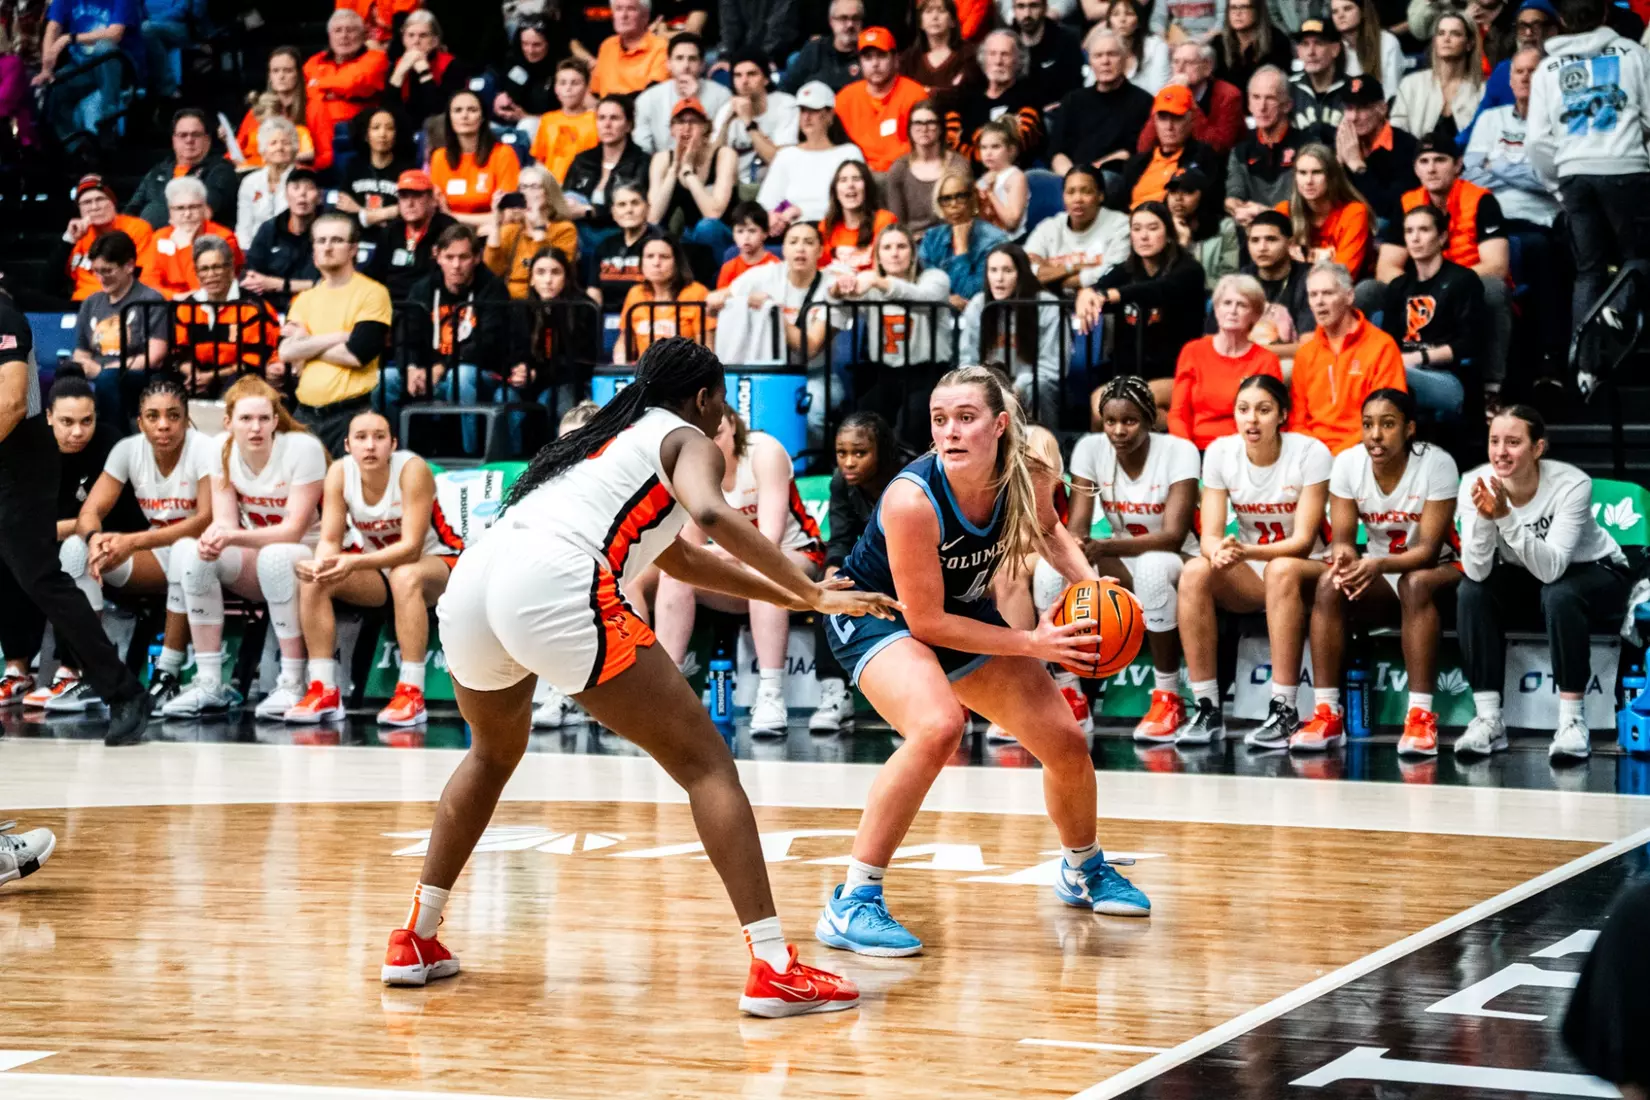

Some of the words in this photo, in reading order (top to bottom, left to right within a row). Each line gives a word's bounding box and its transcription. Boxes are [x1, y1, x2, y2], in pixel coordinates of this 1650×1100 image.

[460, 487, 469, 541] POWERADE
[939, 541, 1008, 569] OLUMB
[785, 657, 816, 675] IAA
[1547, 674, 1603, 694] TA
